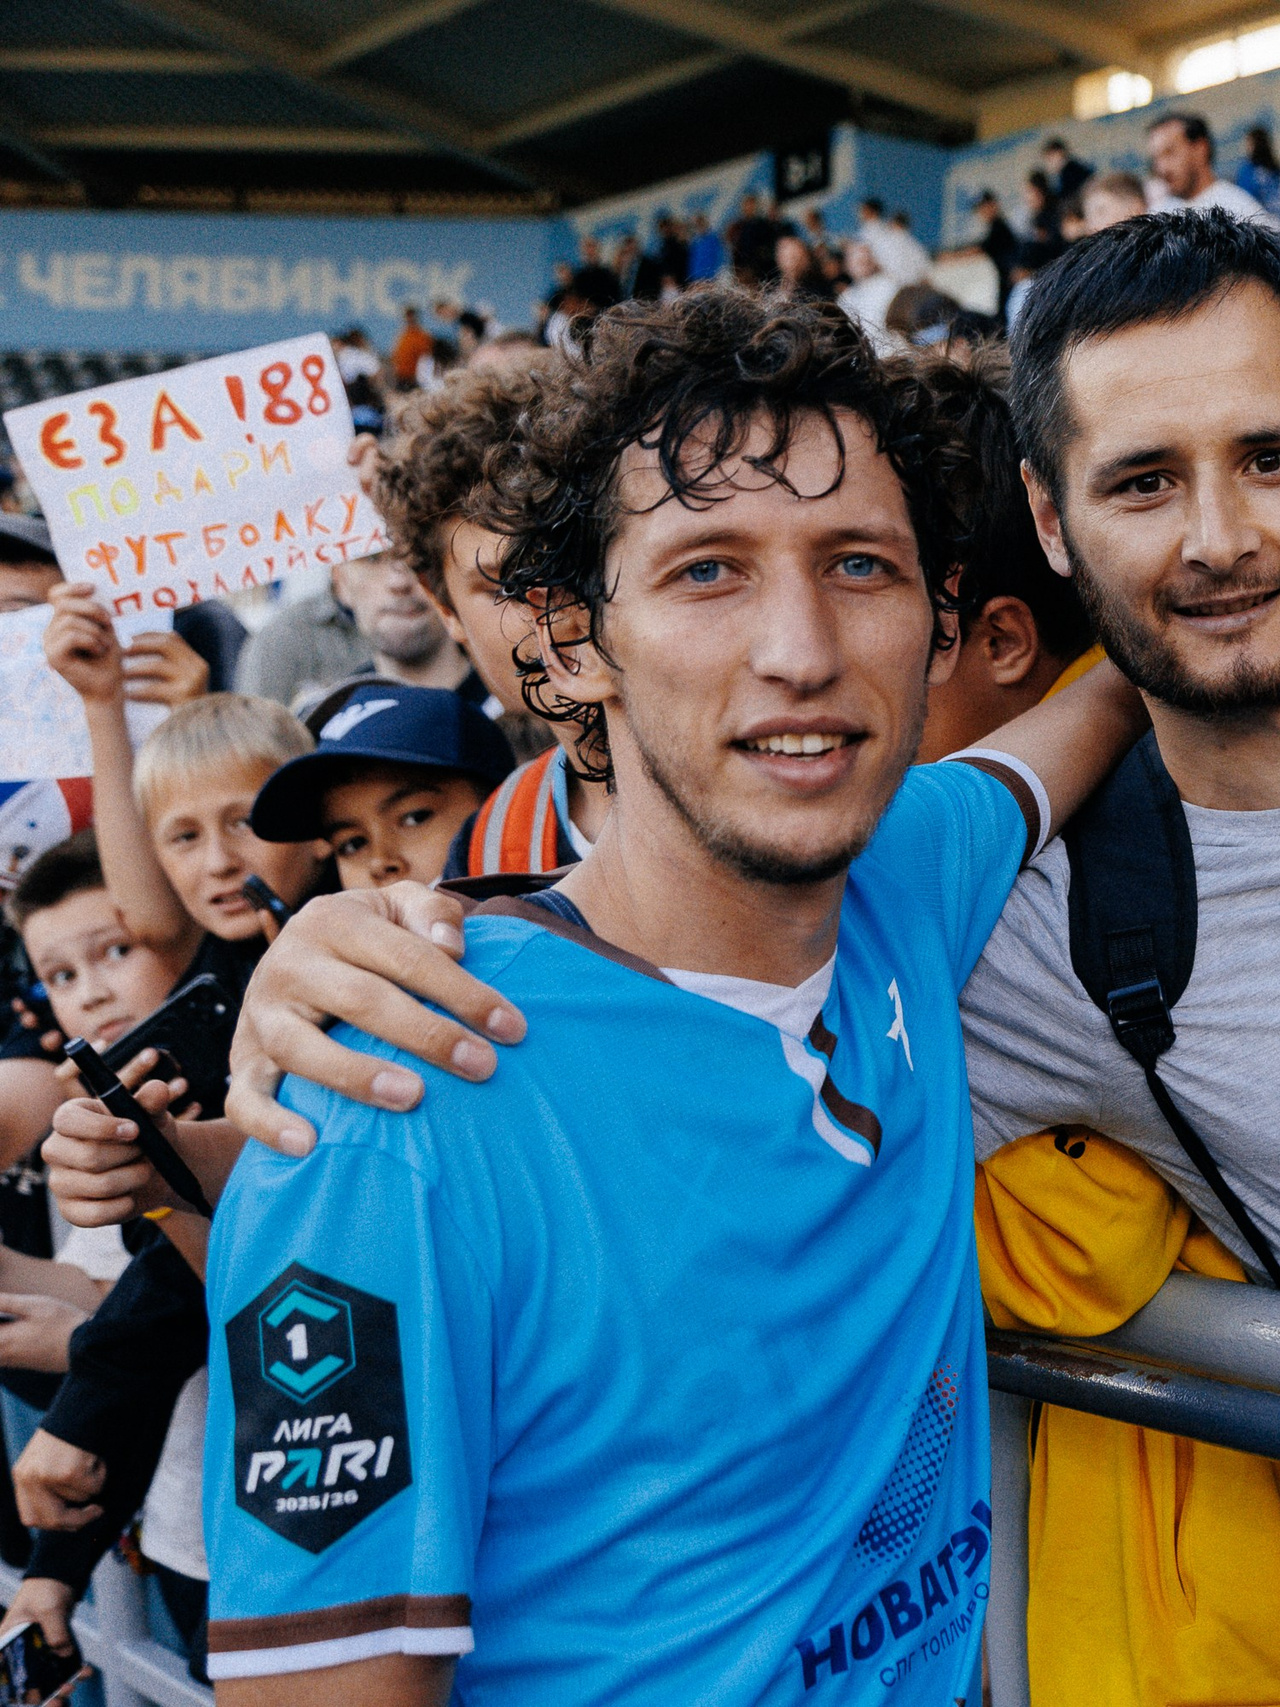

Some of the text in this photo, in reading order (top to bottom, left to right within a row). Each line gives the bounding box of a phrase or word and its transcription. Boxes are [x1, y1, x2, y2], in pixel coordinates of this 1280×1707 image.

[17, 250, 474, 317] ЧЕЛЯБИНСК
[67, 440, 293, 527] ПОДАРИ
[84, 494, 359, 585] ФУТБОЛКУ
[286, 1323, 309, 1361] 1
[273, 1412, 353, 1443] ЛИГА
[245, 1435, 395, 1494] PARI
[276, 1489, 359, 1513] 2025/26
[879, 1582, 990, 1688] СПГ ТОПЛИВО
